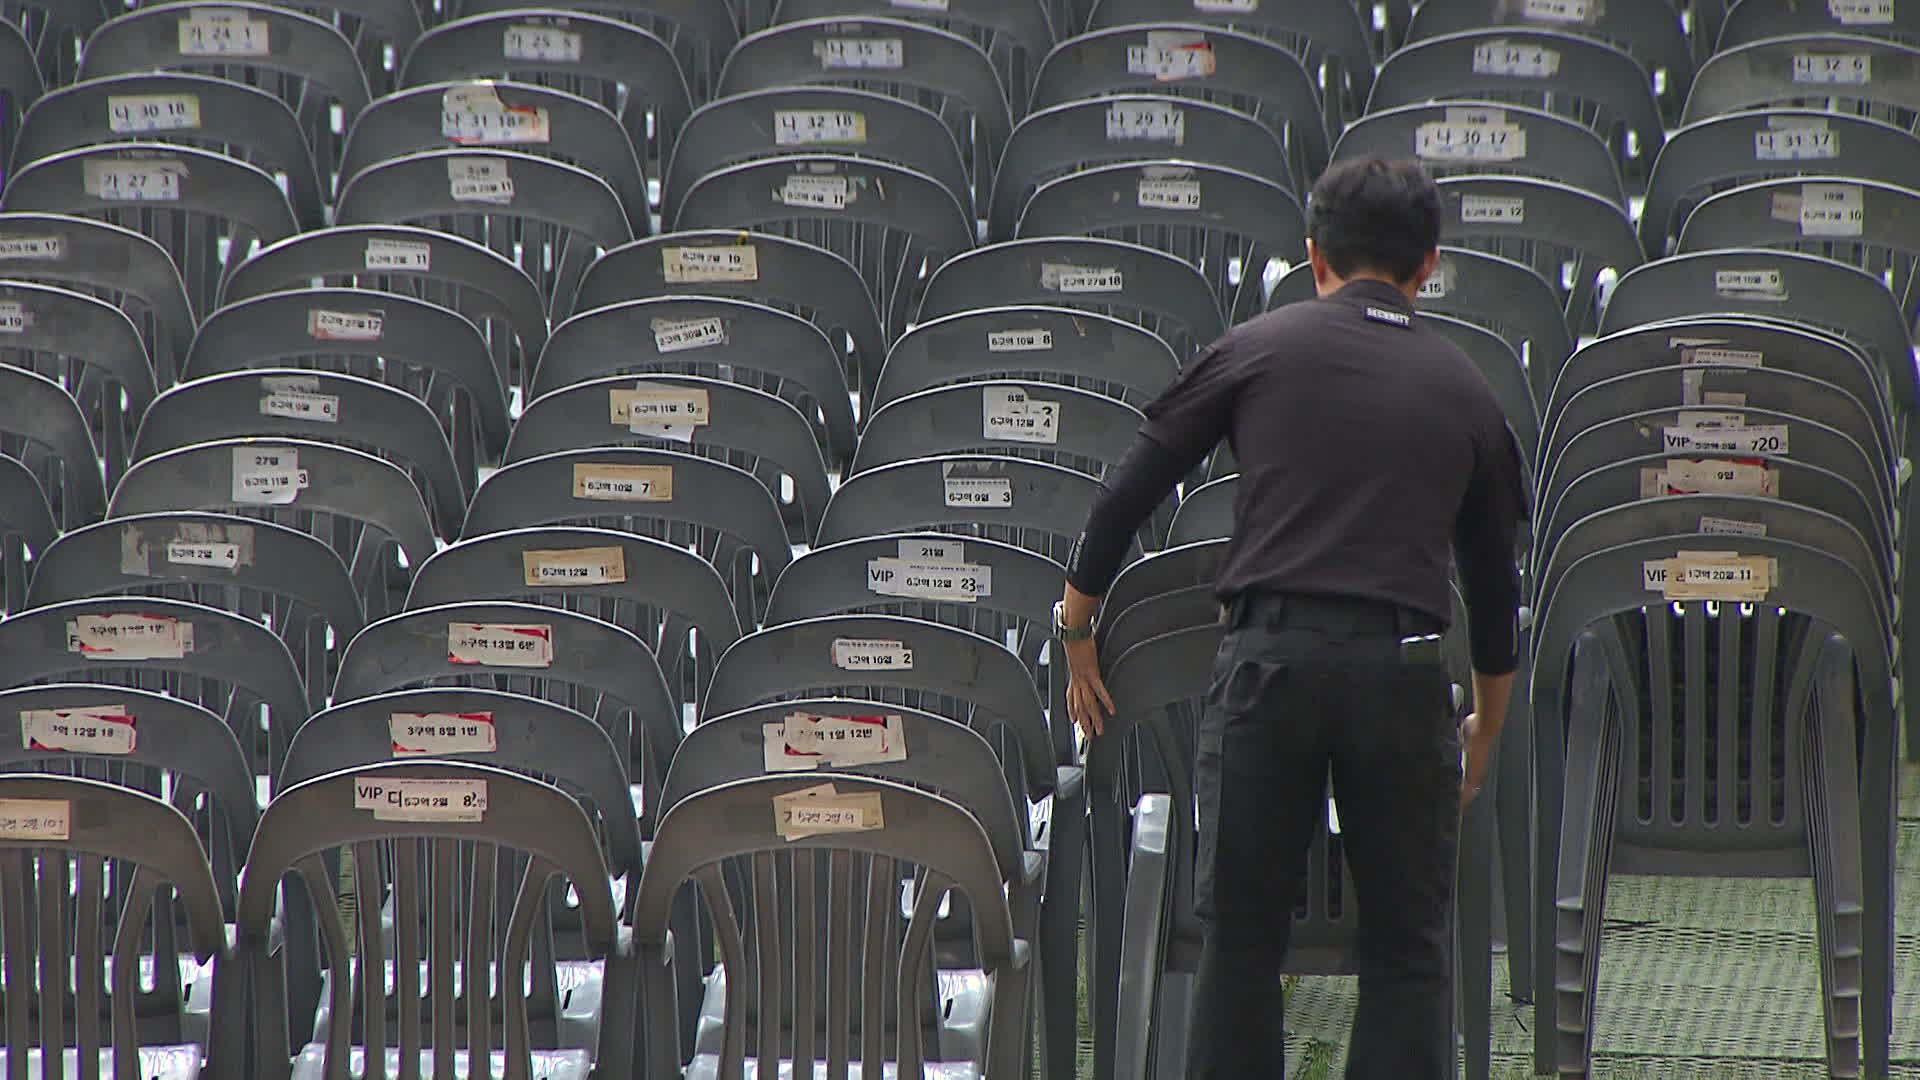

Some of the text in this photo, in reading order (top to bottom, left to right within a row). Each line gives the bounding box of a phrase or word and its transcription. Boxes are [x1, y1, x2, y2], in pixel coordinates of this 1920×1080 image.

[1853, 58, 1863, 70] 6
[144, 103, 159, 118] 30
[168, 102, 185, 116] 18
[836, 114, 853, 127] 18
[1163, 111, 1180, 126] 17
[1464, 130, 1481, 145] 30
[1490, 131, 1507, 145] 17
[1813, 133, 1830, 147] 17
[129, 174, 146, 188] 27
[1186, 193, 1199, 205] 12
[1510, 205, 1522, 217] 12
[416, 254, 427, 265] 11
[1109, 275, 1121, 287] 18
[1769, 273, 1778, 284] 9
[704, 324, 717, 336] 14
[1043, 334, 1051, 345] 8
[634, 404, 657, 414] 6구역
[687, 402, 696, 414] 5
[990, 416, 1052, 428] 6구역 12열 4
[1666, 434, 1691, 448] VIP
[255, 455, 279, 466] 27열
[271, 476, 289, 486] 11열
[299, 472, 308, 484] 3
[1716, 470, 1734, 480] 9열
[588, 481, 651, 494] 6구역 10열 7
[949, 491, 1010, 503] 6구역 9열 3
[225, 549, 234, 560] 4
[921, 547, 944, 557] 21열
[542, 566, 566, 577] 6구역
[569, 567, 588, 577] 12열
[1689, 568, 1711, 580] 1구역
[1740, 568, 1751, 581] 11
[870, 568, 895, 584] VIP
[906, 577, 930, 588] 6구역
[933, 578, 952, 588] 12열
[493, 639, 515, 650] 13열
[518, 639, 535, 650] 6번
[848, 653, 911, 665] 1구역 10열 2
[74, 727, 97, 738] 12열
[102, 728, 114, 737] 18
[408, 725, 478, 737] 3구역 8열 1번
[830, 729, 846, 740] 1열
[851, 728, 872, 739] 12번
[358, 785, 384, 799] VIP
